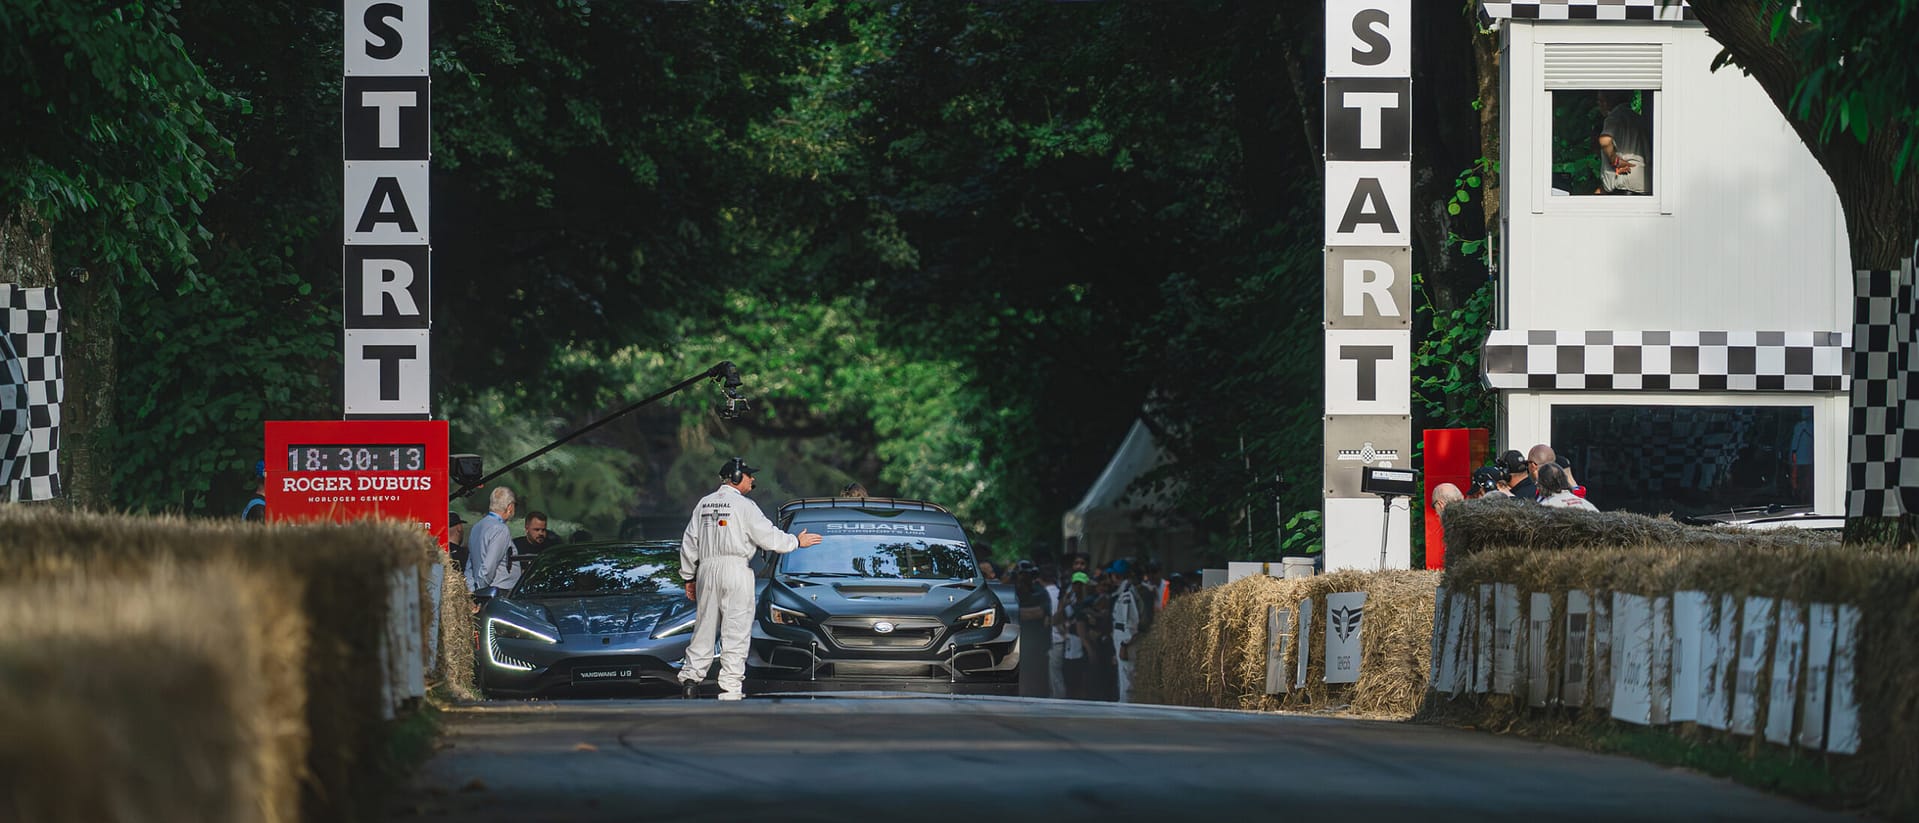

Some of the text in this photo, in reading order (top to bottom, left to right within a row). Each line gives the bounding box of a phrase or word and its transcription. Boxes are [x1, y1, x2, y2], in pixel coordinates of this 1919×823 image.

[355, 2, 418, 401] START
[1337, 9, 1400, 401] START
[282, 476, 431, 492] ROGER DUBUIS
[826, 523, 925, 532] SUBARU
